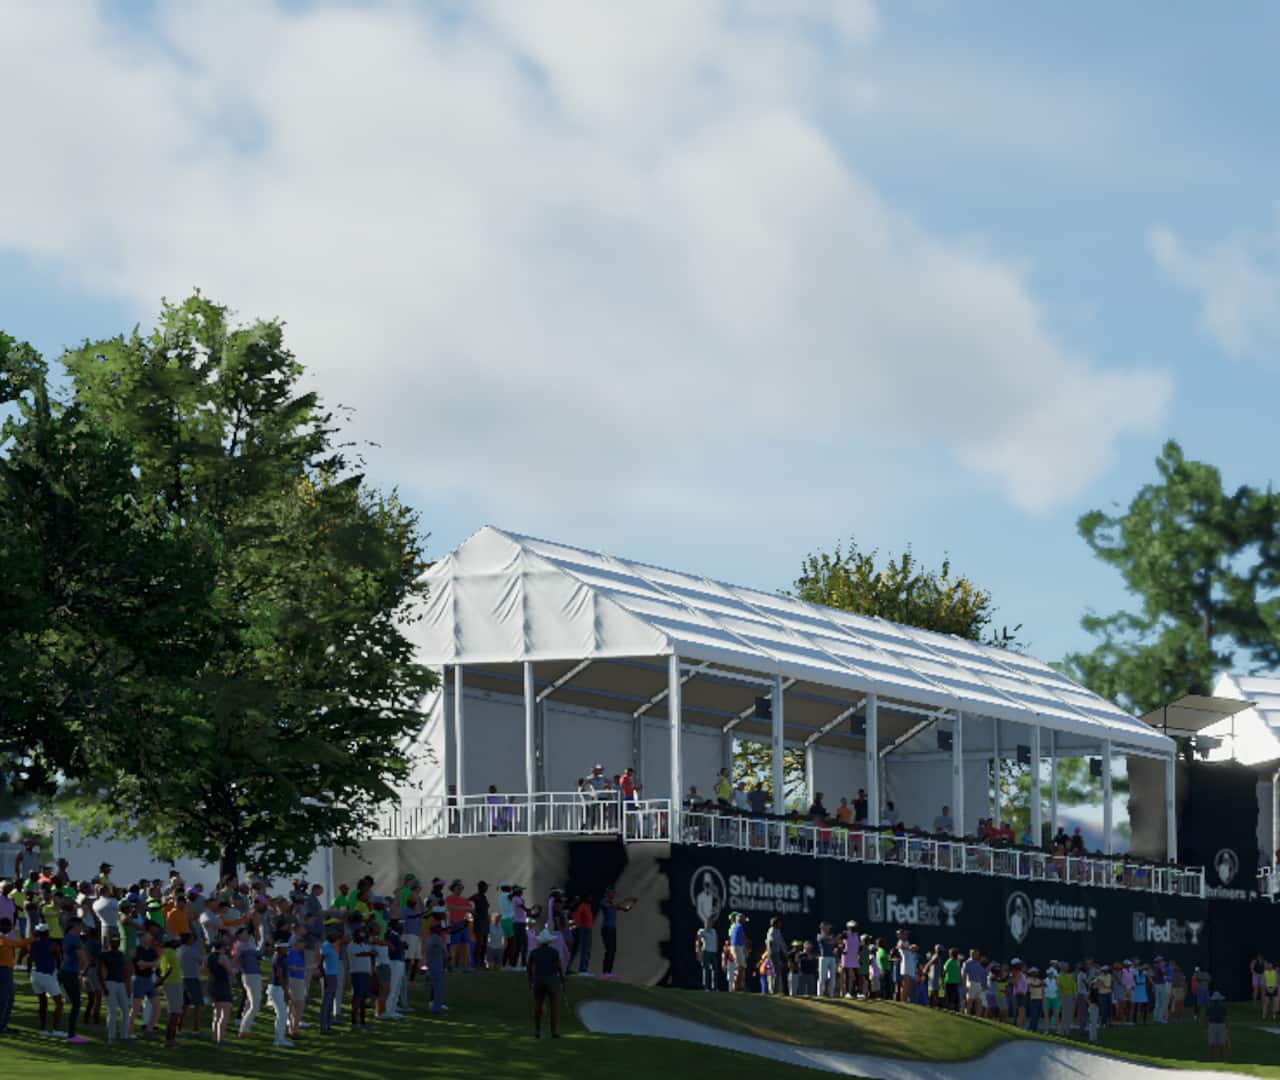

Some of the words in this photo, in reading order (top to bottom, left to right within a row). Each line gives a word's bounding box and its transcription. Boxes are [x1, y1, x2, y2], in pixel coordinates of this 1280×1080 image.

[729, 875, 799, 899] Shriners
[1204, 885, 1246, 899] hriners
[775, 900, 802, 914] Open
[886, 895, 941, 925] FedEx
[1033, 898, 1085, 919] Shriners
[1146, 917, 1187, 944] FedEx
